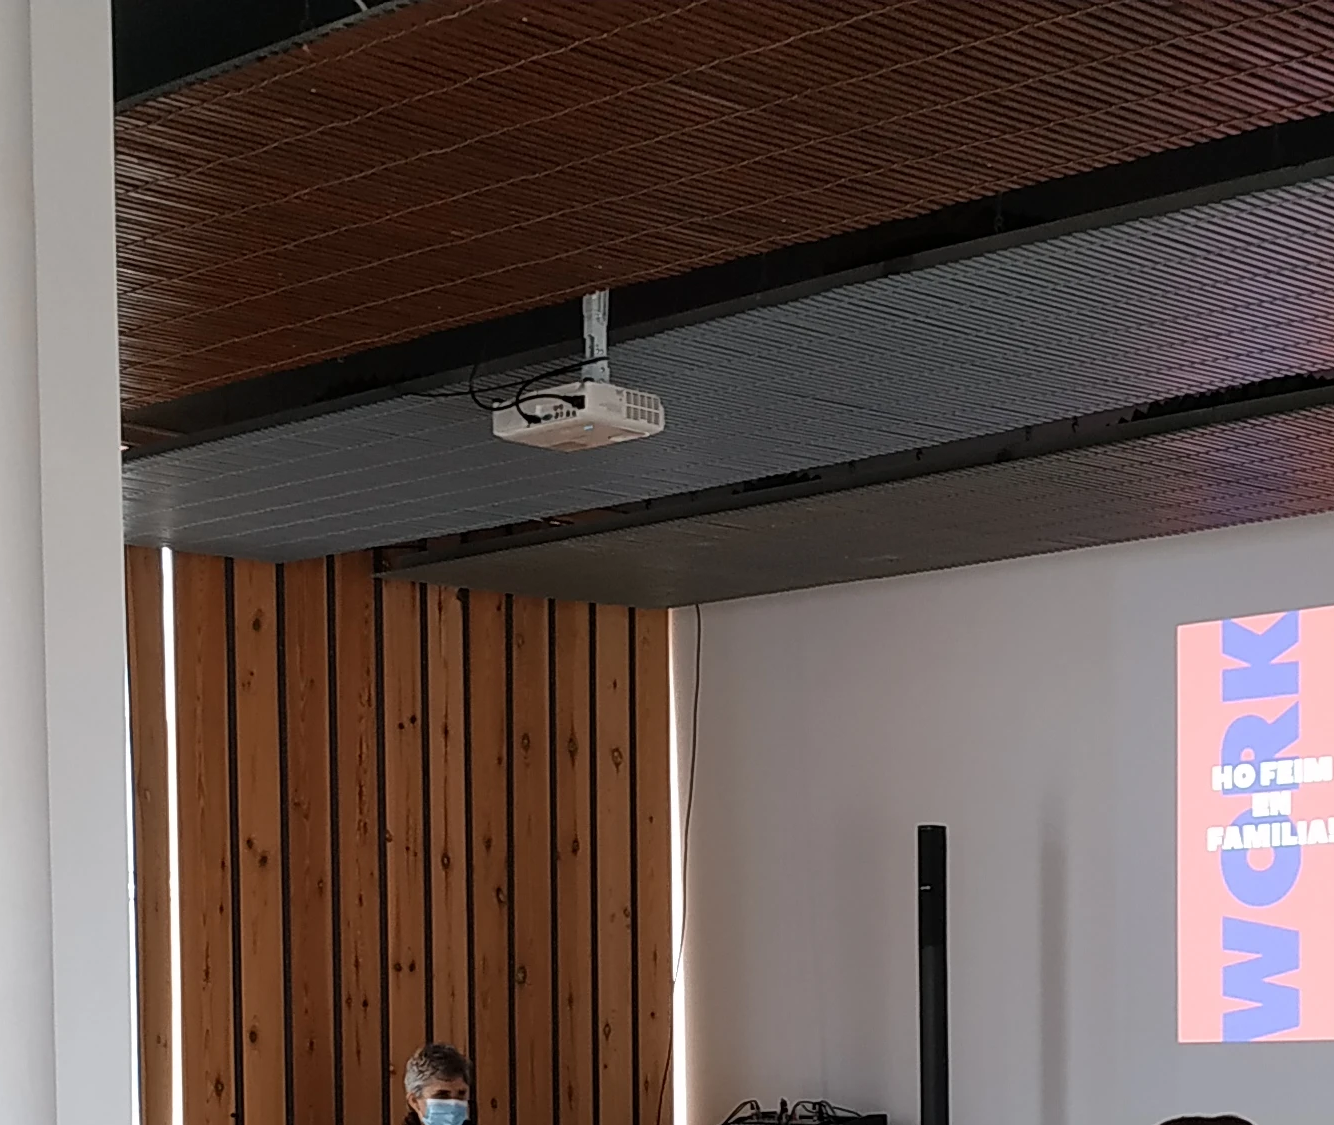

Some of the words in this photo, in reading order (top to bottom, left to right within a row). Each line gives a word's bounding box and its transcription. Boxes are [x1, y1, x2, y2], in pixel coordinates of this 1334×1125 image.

[1211, 762, 1256, 791] HO
[1259, 755, 1334, 787] FEIM
[1251, 789, 1292, 818] EN
